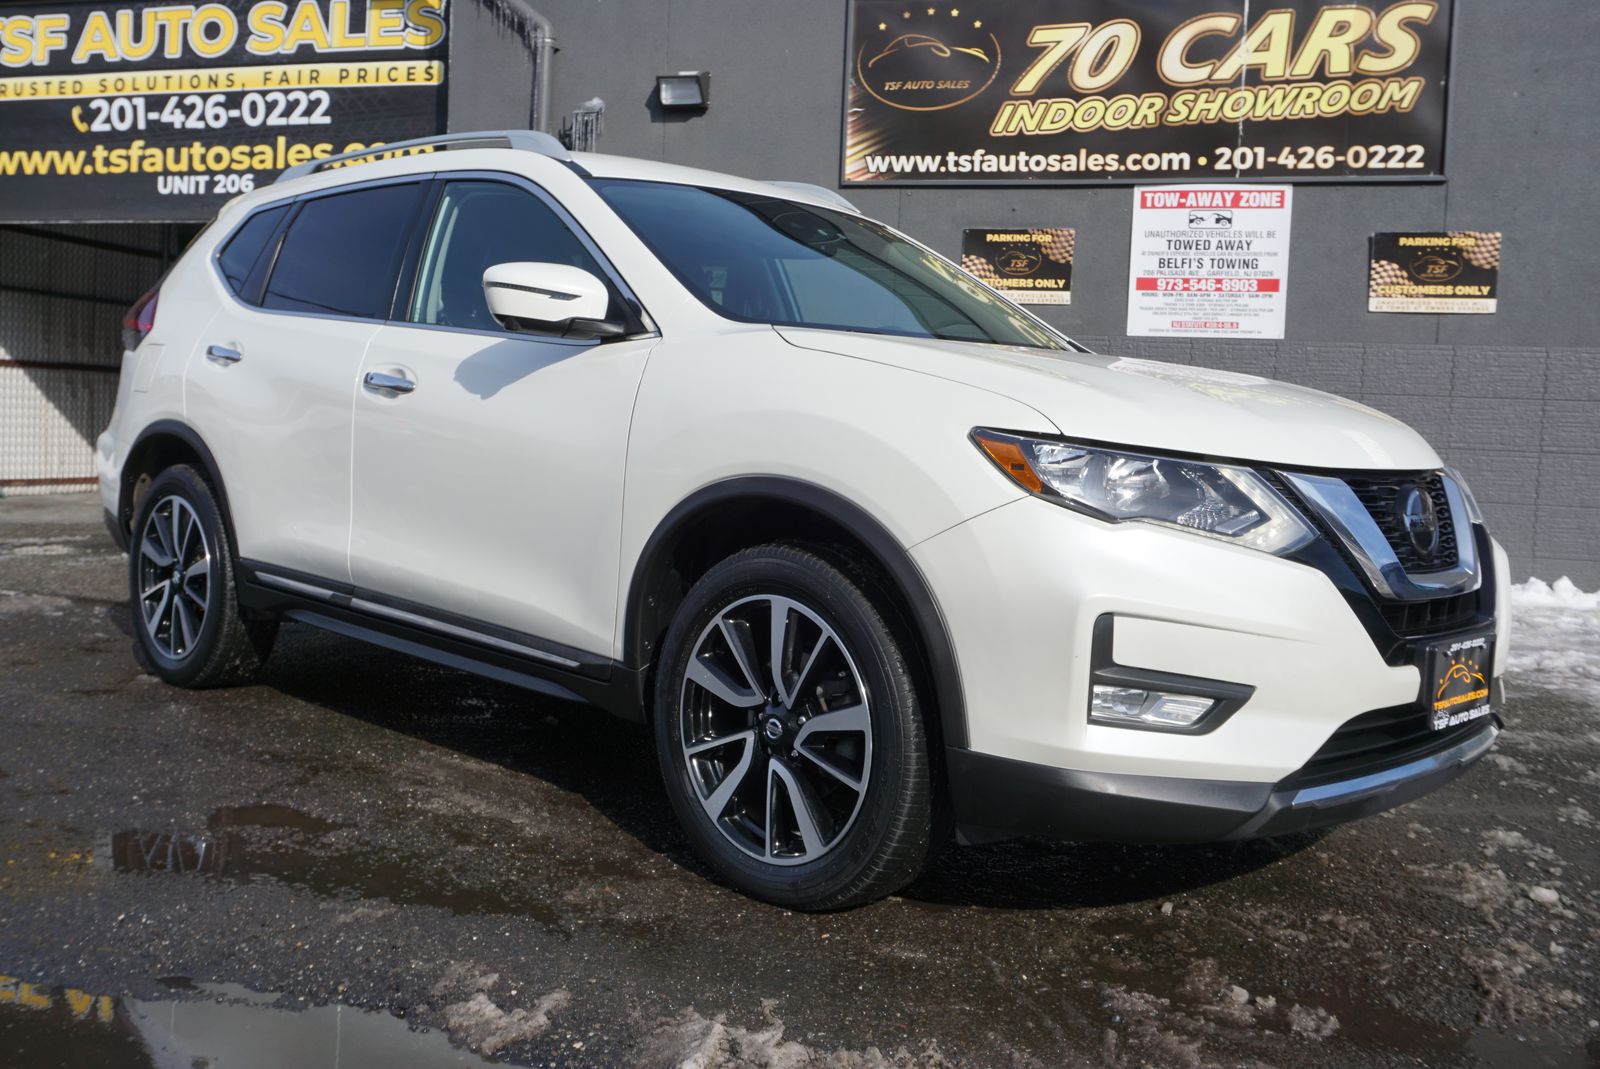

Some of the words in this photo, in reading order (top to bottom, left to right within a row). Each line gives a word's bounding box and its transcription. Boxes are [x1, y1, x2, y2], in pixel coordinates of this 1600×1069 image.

[0, 14, 70, 67] SF
[71, 3, 238, 64] AUTO
[245, 0, 447, 52] SALES
[1009, 18, 1143, 98] 70
[1157, 1, 1440, 86] CARS
[99, 72, 247, 93] SOLUTIONS,
[263, 69, 321, 86] FAIR
[339, 65, 437, 83] PRICES
[884, 81, 903, 91] TSF
[903, 80, 935, 90] AUTO
[936, 79, 971, 89] SALES
[89, 90, 332, 132] 201-426-0222
[990, 91, 1164, 137] INDOOR
[1166, 77, 1425, 124] SHOWROOM
[865, 145, 1191, 174] www.tsfautosales.com
[1215, 144, 1425, 172] 201-426-0222
[157, 174, 210, 195] UNIT
[213, 173, 255, 194] 206
[1144, 192, 1235, 208] TOW-AWAY
[1239, 192, 1281, 207] ZONE
[986, 233, 1031, 242] PARKING
[1031, 233, 1053, 243] FOR
[1144, 230, 1204, 238] UNAUTHORIZED
[1205, 230, 1243, 239] VEHICLES
[1245, 231, 1264, 239] WILL
[1266, 231, 1277, 239] BE
[1166, 239, 1211, 251] TOWED
[1216, 239, 1253, 251] AWAY
[1399, 237, 1451, 246] PARKING
[1451, 237, 1476, 247] FOR
[1010, 259, 1029, 268] TSF
[1158, 257, 1204, 269] BELFI'S
[1209, 258, 1259, 270] TOWING
[1426, 264, 1448, 273] TSF
[981, 278, 1034, 288] STOMERS
[1034, 278, 1066, 289] ONLY
[1156, 278, 1258, 291] 973-546-8903
[1377, 285, 1454, 295] CUSTOMERS
[1454, 285, 1491, 296] ONLY
[1448, 711, 1469, 726] AUTO
[1469, 704, 1491, 721] SALES
